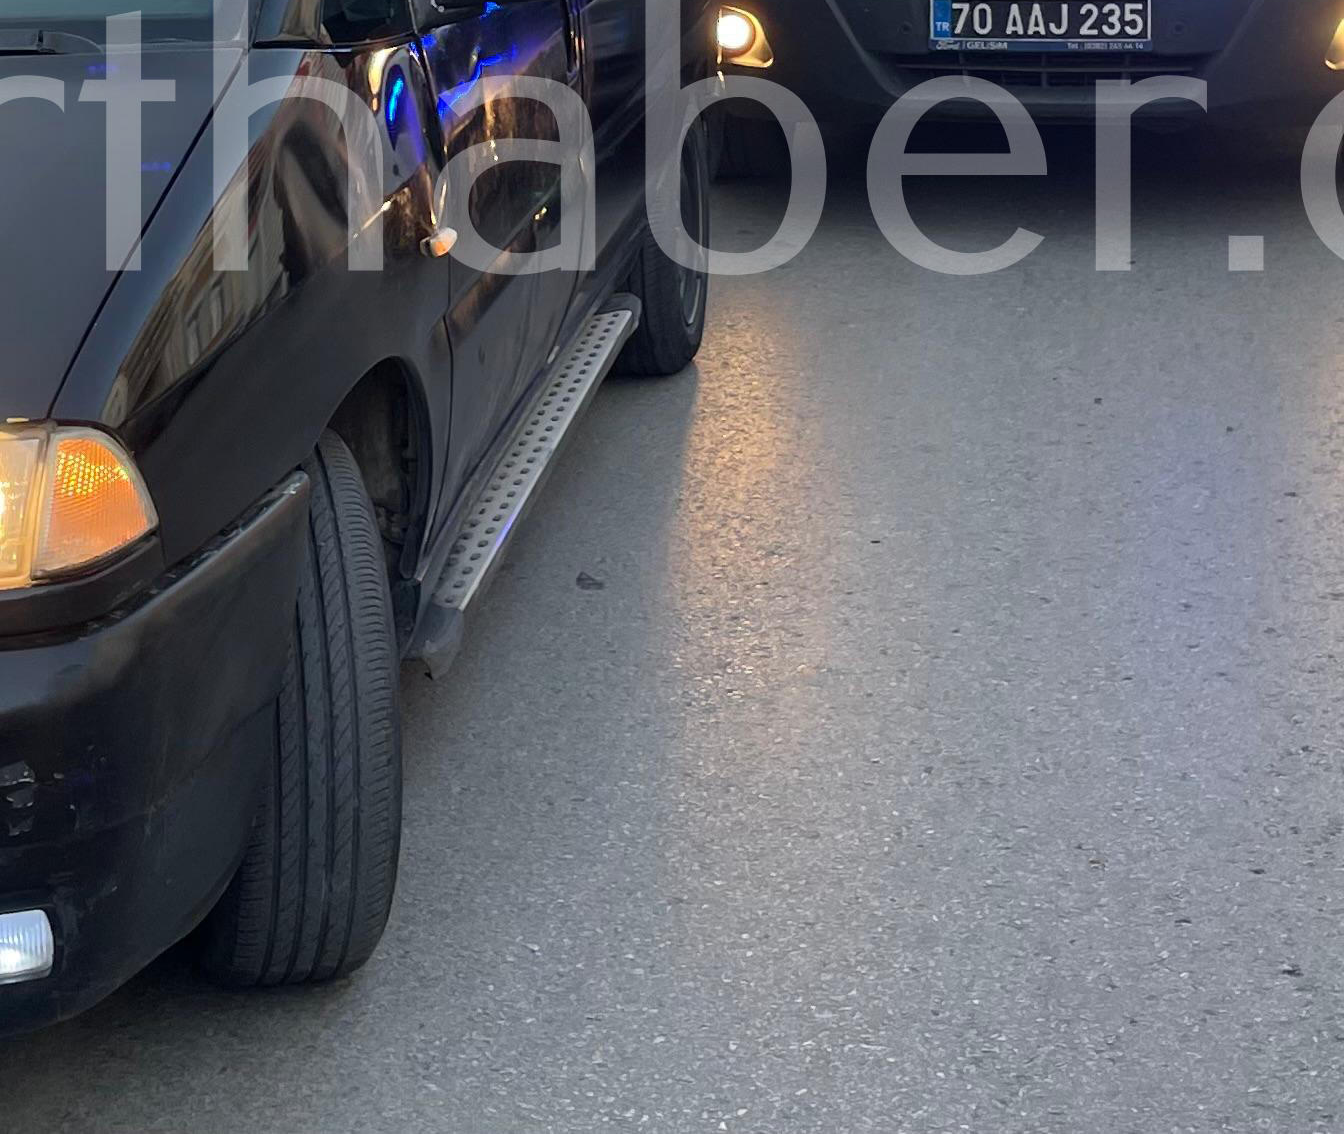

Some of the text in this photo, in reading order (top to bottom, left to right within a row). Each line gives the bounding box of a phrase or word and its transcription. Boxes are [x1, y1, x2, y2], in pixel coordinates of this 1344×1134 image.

[935, 3, 1143, 35] TR 70 AAJ 235
